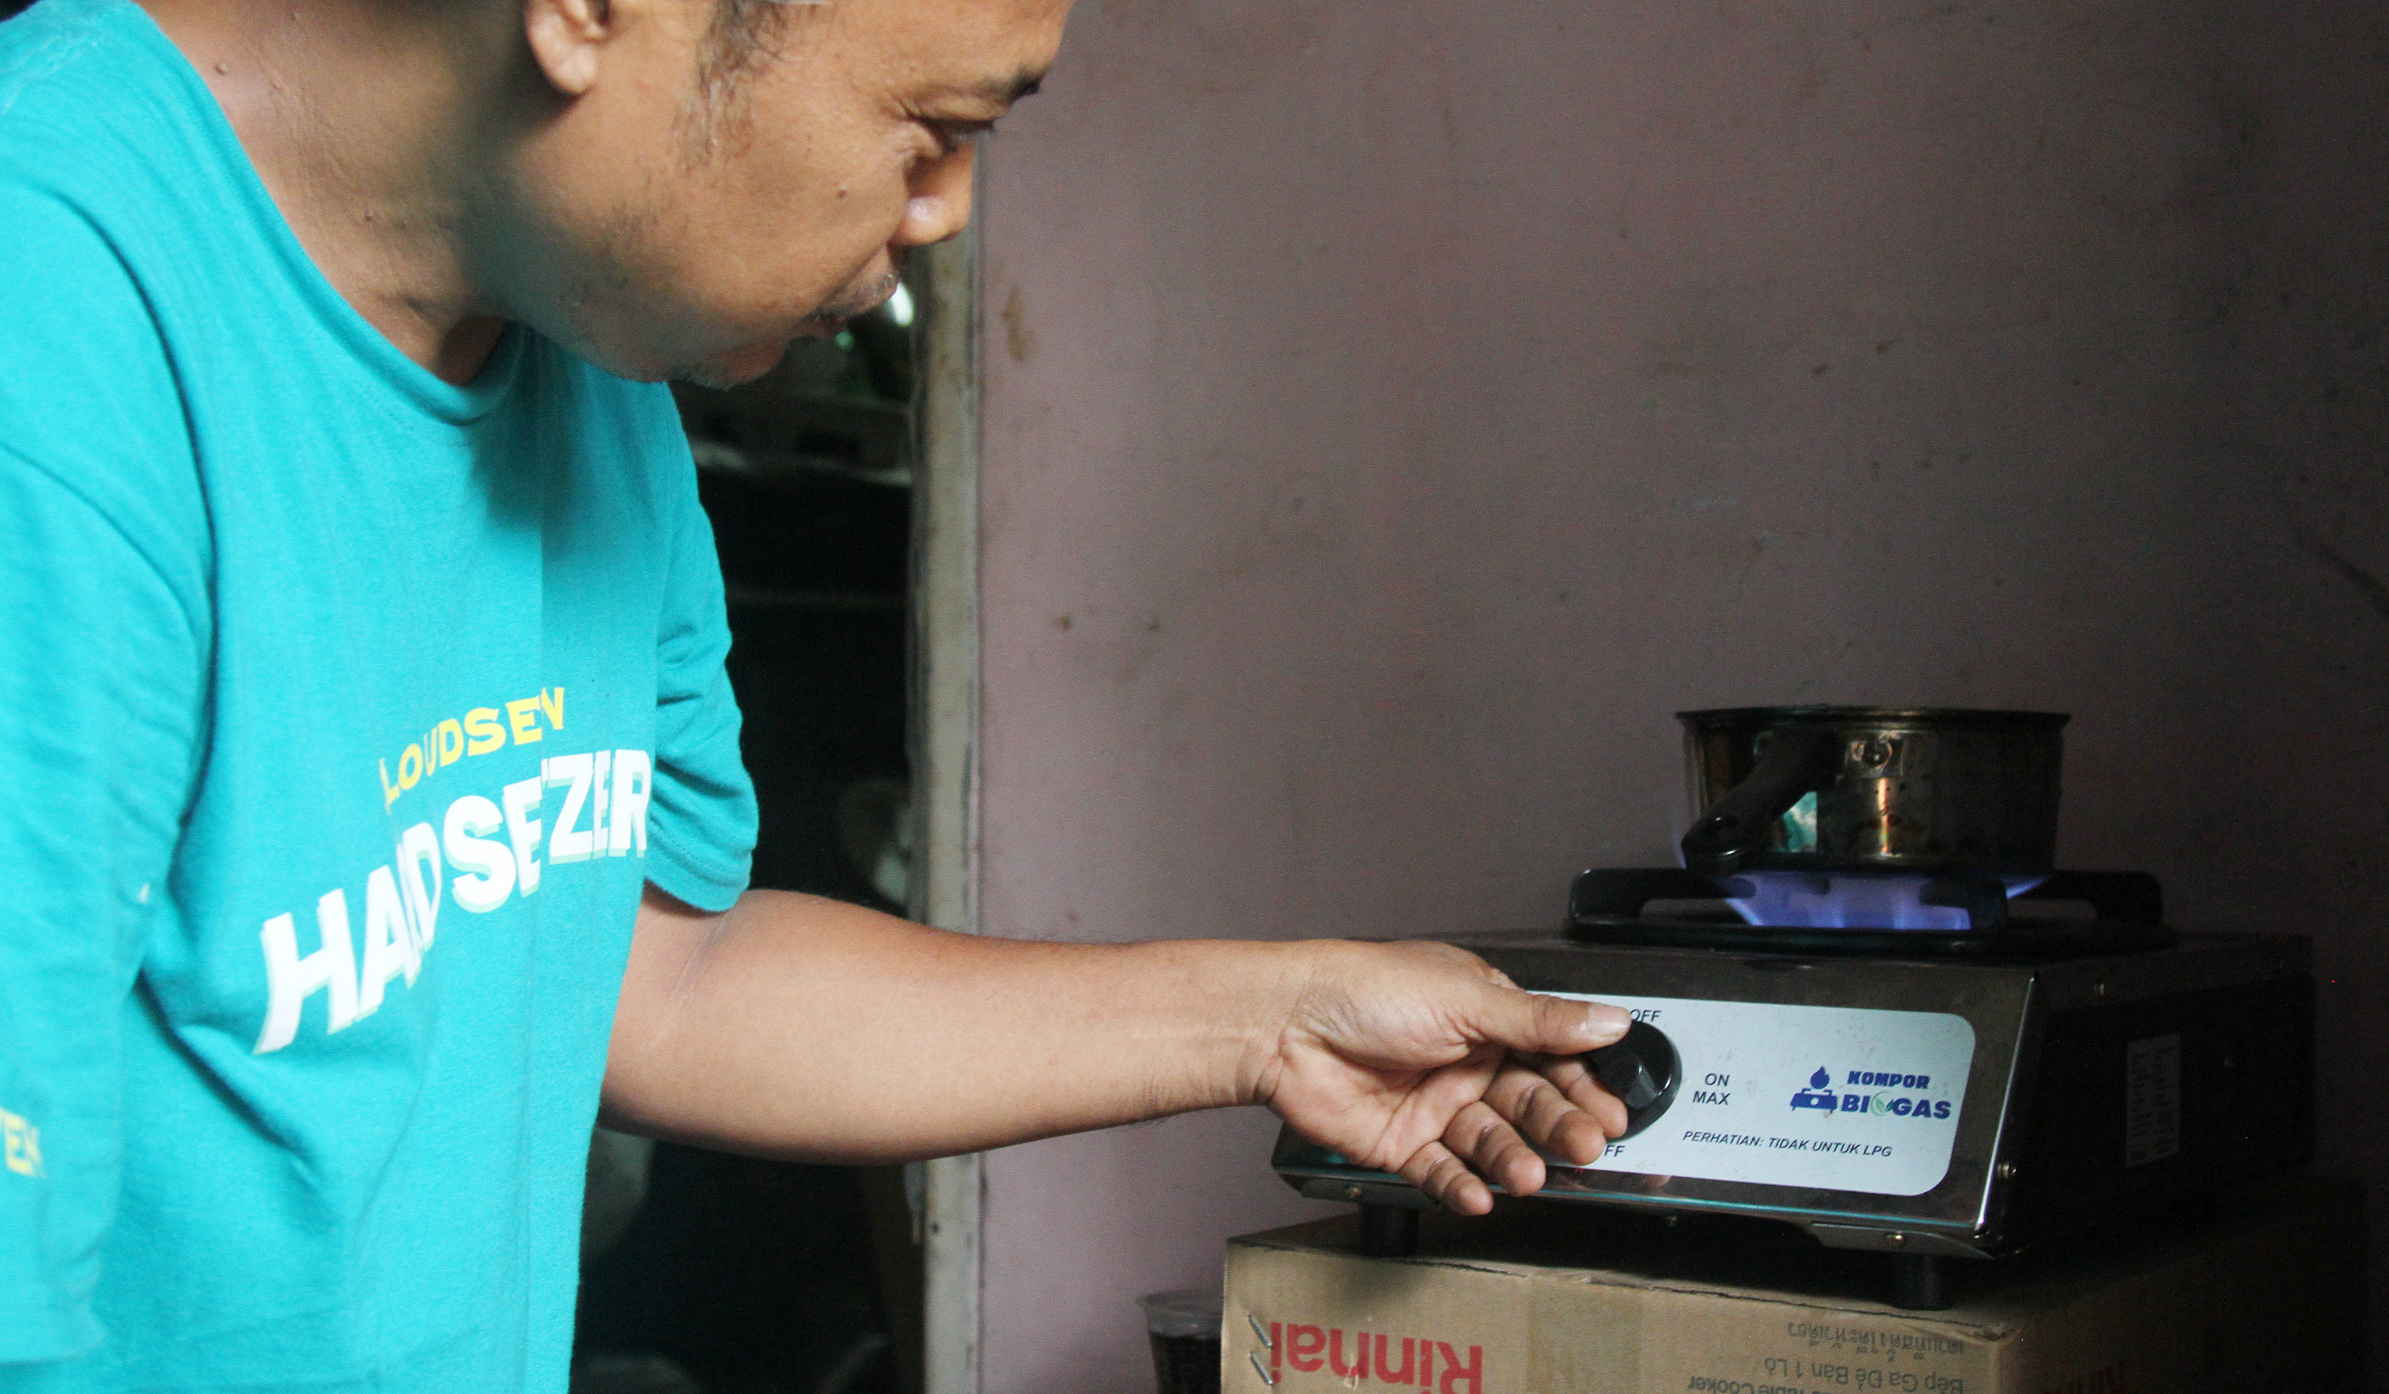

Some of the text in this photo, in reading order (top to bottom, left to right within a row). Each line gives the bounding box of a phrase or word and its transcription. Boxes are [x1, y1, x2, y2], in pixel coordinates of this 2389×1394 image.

[1629, 1008, 1662, 1022] OFF
[1705, 1073, 1730, 1087] ON
[1847, 1070, 1930, 1089] KOMPOR
[1693, 1091, 1731, 1106] MAX
[1841, 1091, 1951, 1119] BIOGAS
[1604, 1144, 1626, 1158] FF
[1682, 1130, 1893, 1158] PERHATIAN: TIDAK UNTUK LPG
[1270, 1321, 1483, 1394] Rinnai
[1796, 1360, 1804, 1379] 1
[1889, 1371, 1918, 1393] Ga
